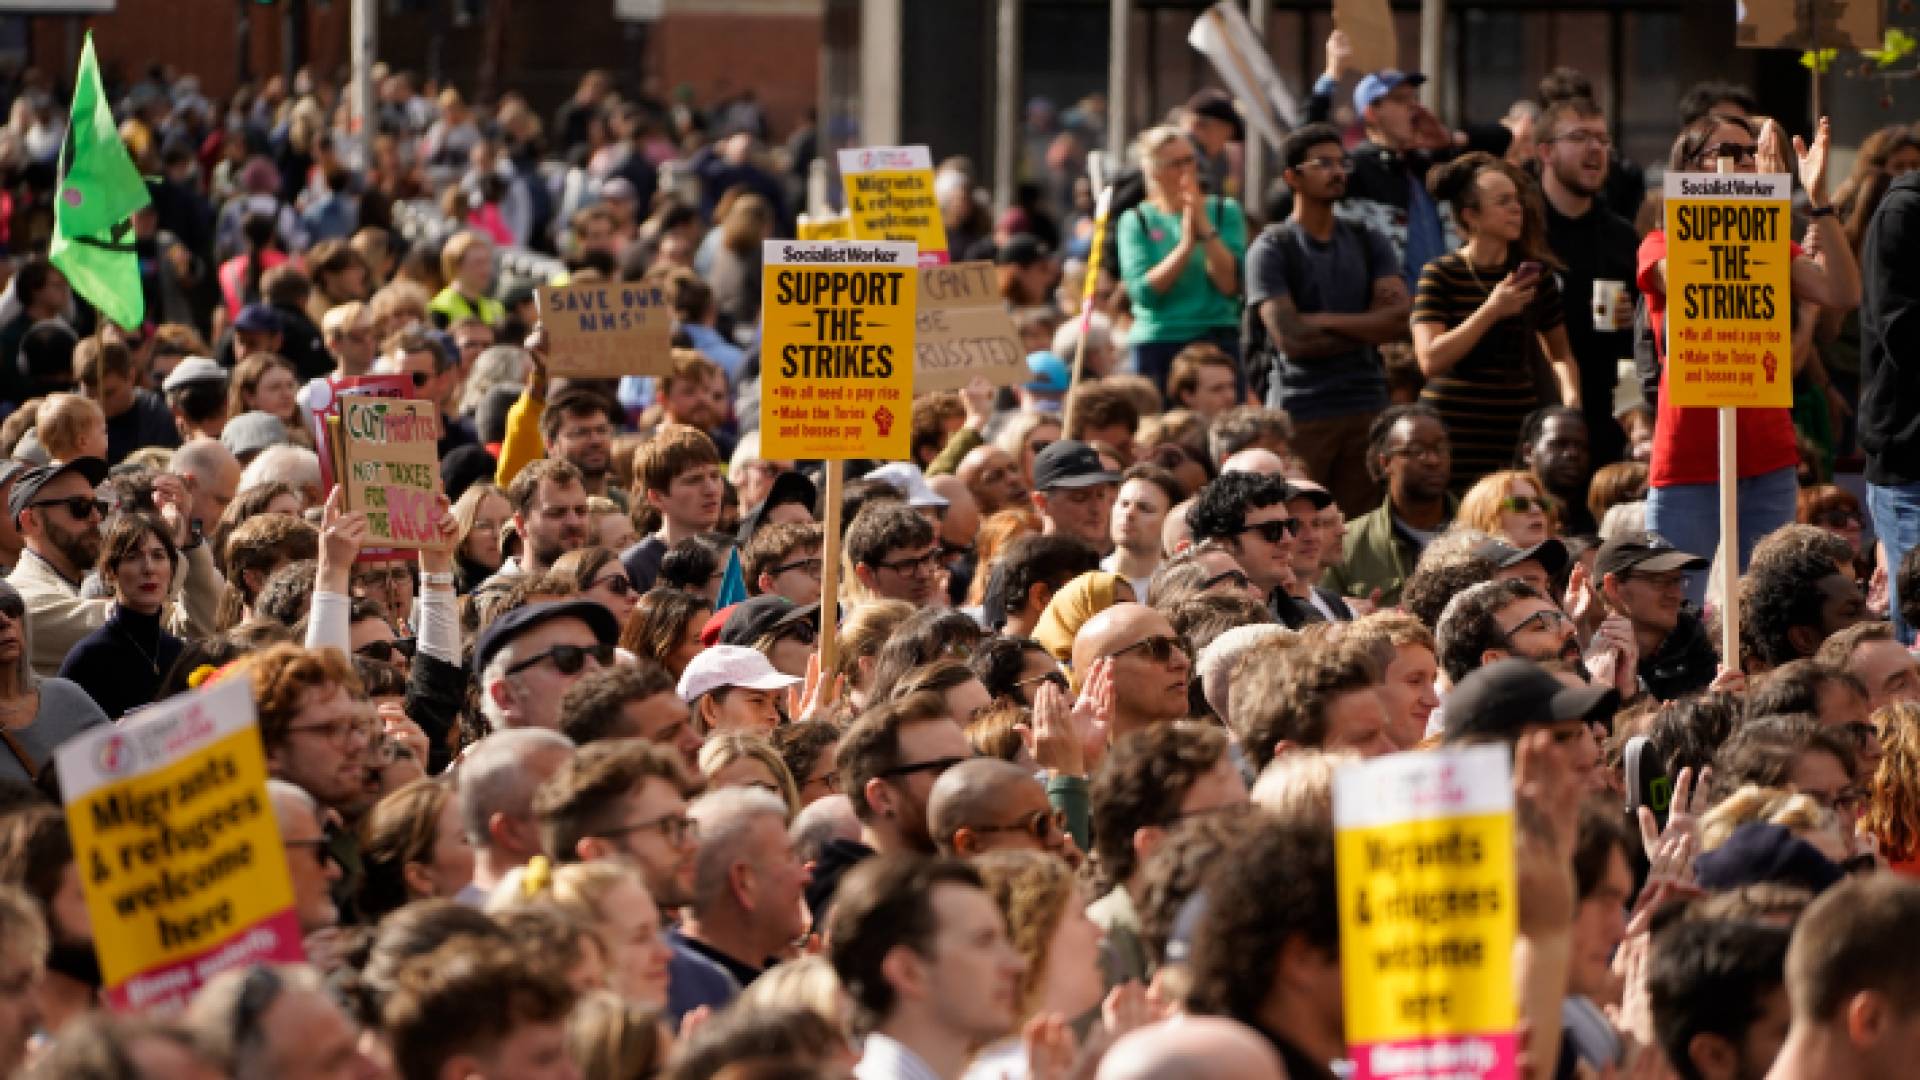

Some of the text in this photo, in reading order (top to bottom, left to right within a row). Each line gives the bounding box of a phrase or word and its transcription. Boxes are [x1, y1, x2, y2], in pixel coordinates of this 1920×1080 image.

[1677, 205, 1780, 241] SUPPORT
[1709, 245, 1751, 280] THE
[550, 288, 664, 312] SAVE OUR
[777, 271, 904, 305] SUPPORT
[1684, 284, 1775, 320] STRIKES
[813, 307, 864, 341] THE
[1717, 329, 1736, 342] need
[1749, 330, 1761, 346] pay
[780, 344, 894, 379] STRIKES
[1684, 348, 1709, 365] Make
[1712, 348, 1728, 365] the
[780, 386, 900, 402] We all need a pay rise
[1684, 369, 1702, 384] and
[1740, 371, 1753, 386] pay
[780, 405, 866, 419] Make the Tories
[780, 425, 862, 440] and bosses pay
[385, 461, 433, 489] TAXES
[93, 755, 239, 830] Migrants
[119, 794, 261, 869] refugees
[113, 844, 254, 916] welcome
[157, 898, 233, 948] here
